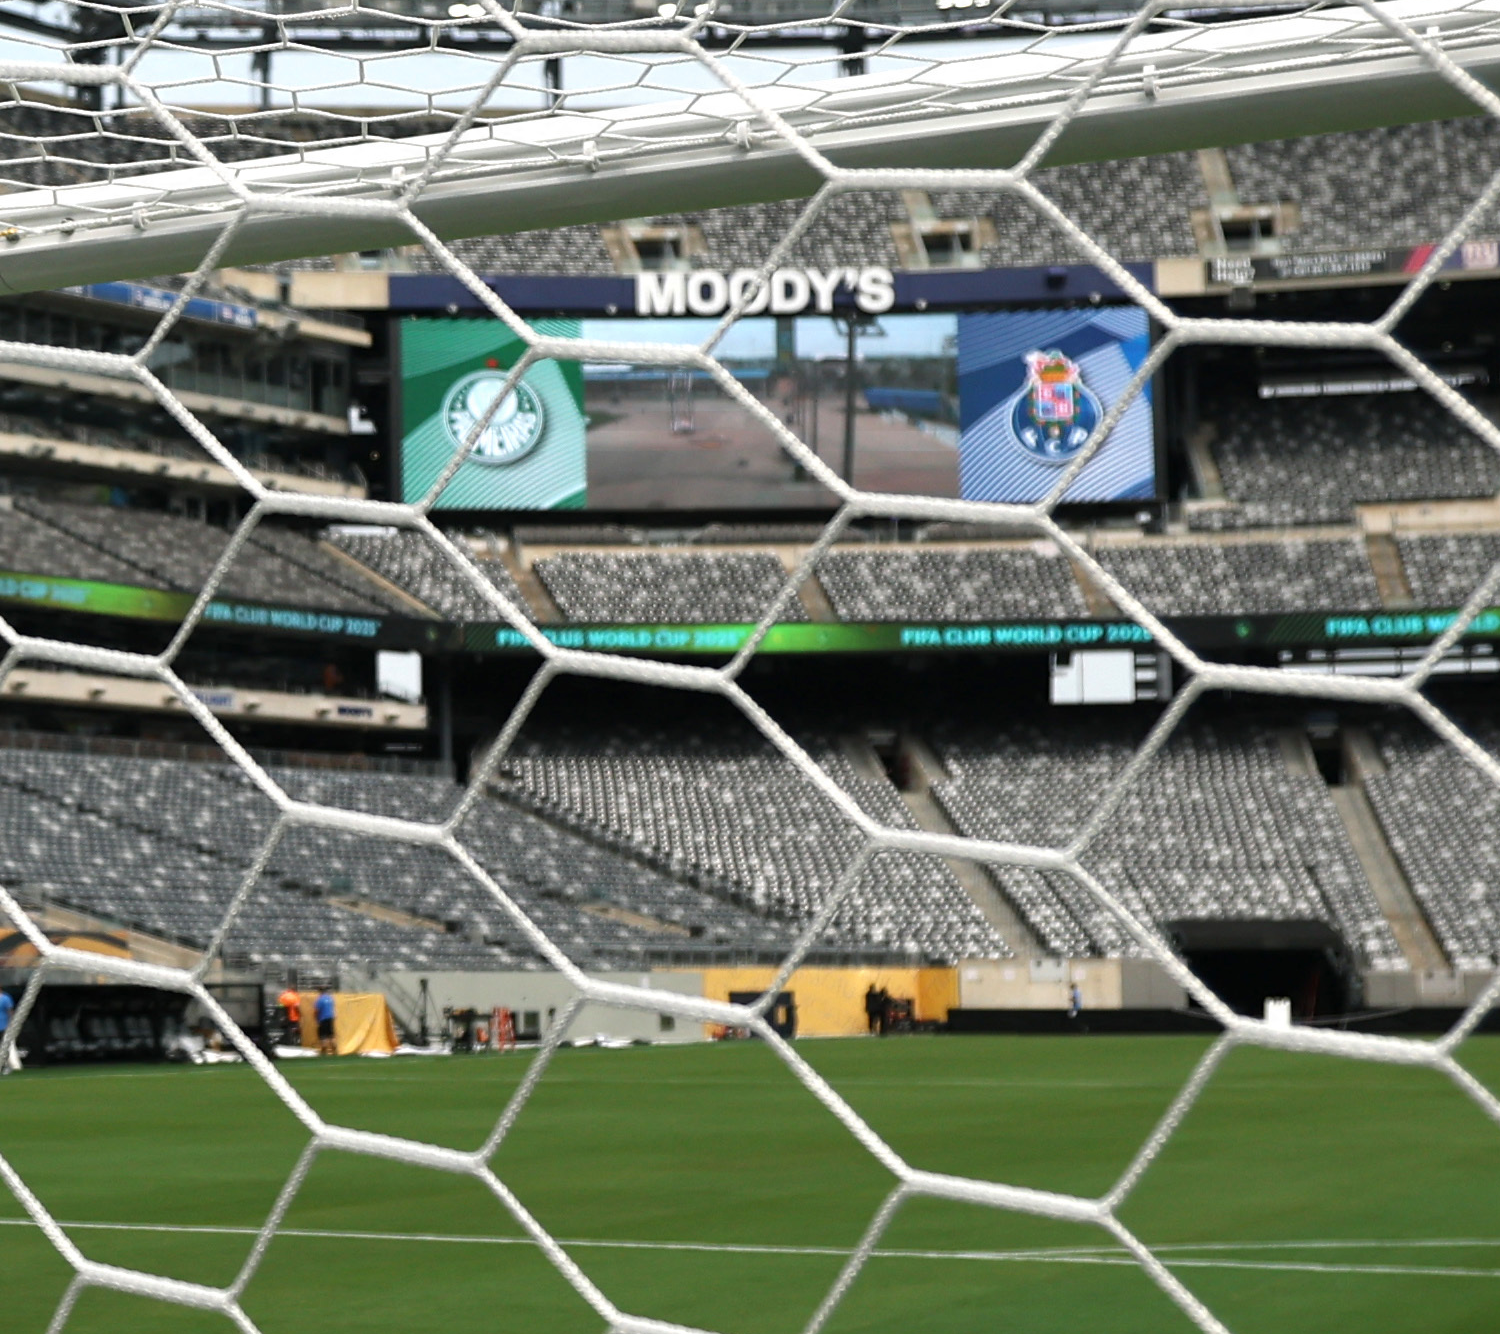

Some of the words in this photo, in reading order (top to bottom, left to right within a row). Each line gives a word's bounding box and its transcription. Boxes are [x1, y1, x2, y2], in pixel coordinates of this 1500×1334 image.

[636, 267, 896, 316] MOODY'S
[204, 601, 232, 622] FIFA
[234, 605, 268, 626] CLUB
[270, 608, 317, 630] WORLD
[320, 614, 344, 633] CUP
[1326, 617, 1370, 637] FIFA
[588, 629, 652, 648] WORLD
[655, 629, 692, 647] CUP
[903, 626, 942, 646] FIFA
[944, 625, 992, 646] CLUB
[994, 624, 1063, 645] WORLD
[1064, 624, 1104, 643] CUP
